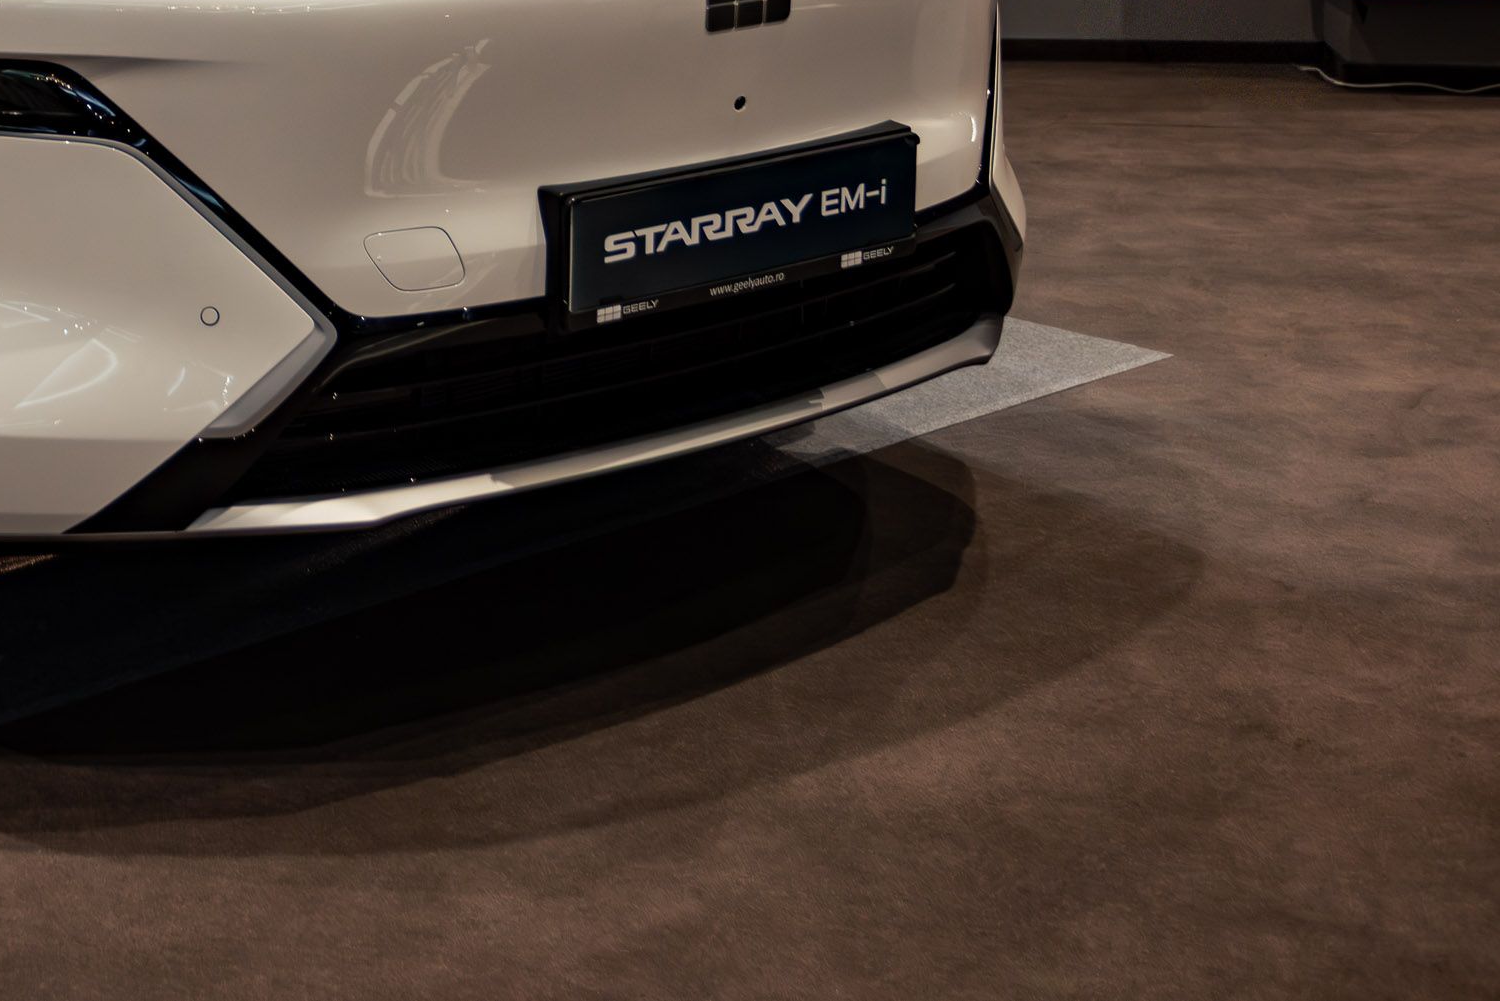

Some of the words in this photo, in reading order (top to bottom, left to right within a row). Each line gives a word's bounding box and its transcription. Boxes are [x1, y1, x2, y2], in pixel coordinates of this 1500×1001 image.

[603, 193, 814, 265] STARRAY
[820, 178, 888, 217] EM-i
[862, 246, 895, 261] GEELY
[709, 272, 786, 297] www.geelyauto.ro
[622, 299, 659, 315] GEELY
